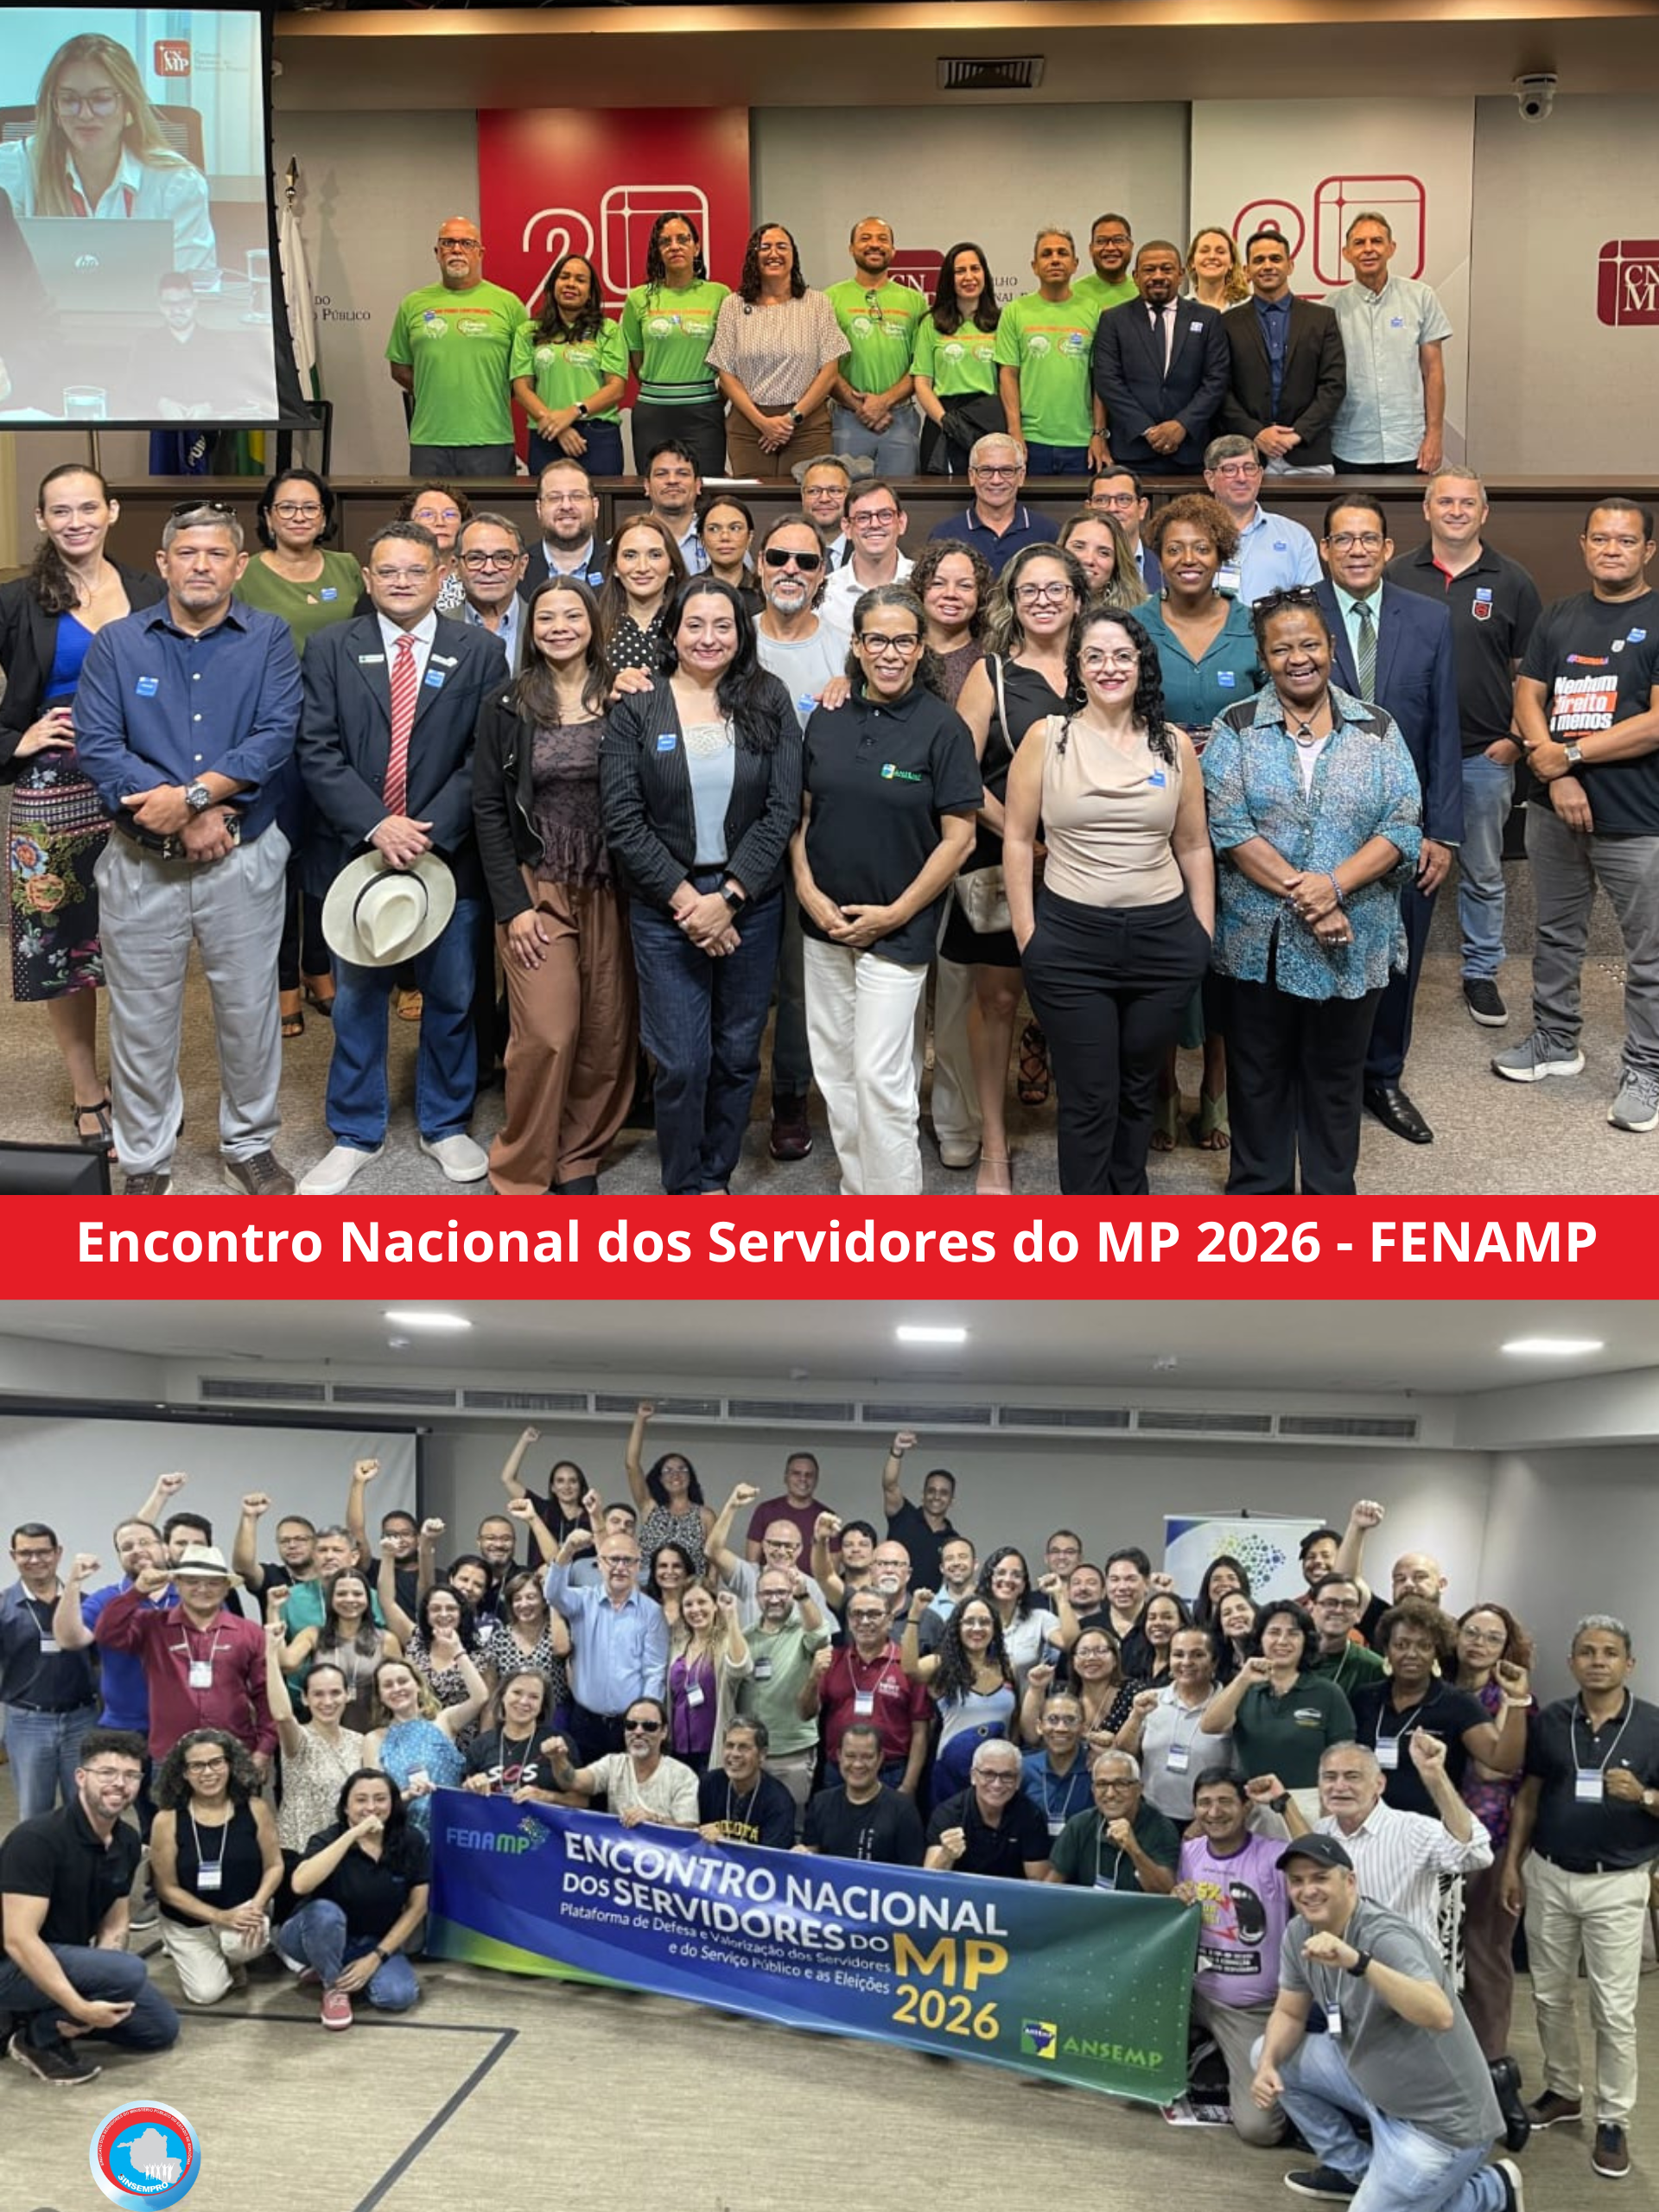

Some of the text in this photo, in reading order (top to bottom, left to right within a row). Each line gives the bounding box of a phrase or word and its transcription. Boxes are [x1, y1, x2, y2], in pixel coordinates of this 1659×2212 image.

[315, 296, 331, 306] DO
[1554, 675, 1618, 695] Nenhum
[1558, 713, 1613, 731] menos
[488, 1763, 538, 1783] SOS
[447, 1827, 530, 1855] FENAMP
[564, 1831, 1008, 1936] ENCONTRO NACIONAL
[560, 1902, 892, 1974] Plataforma de Defesa e Valorização dos Servidores
[563, 1872, 1009, 1992] DOS SERVIDORES DO MP
[668, 1942, 890, 1995] e do Serviço Público e as Eleições
[892, 1984, 1000, 2041] 2026
[1063, 2036, 1163, 2068] ANSEMP
